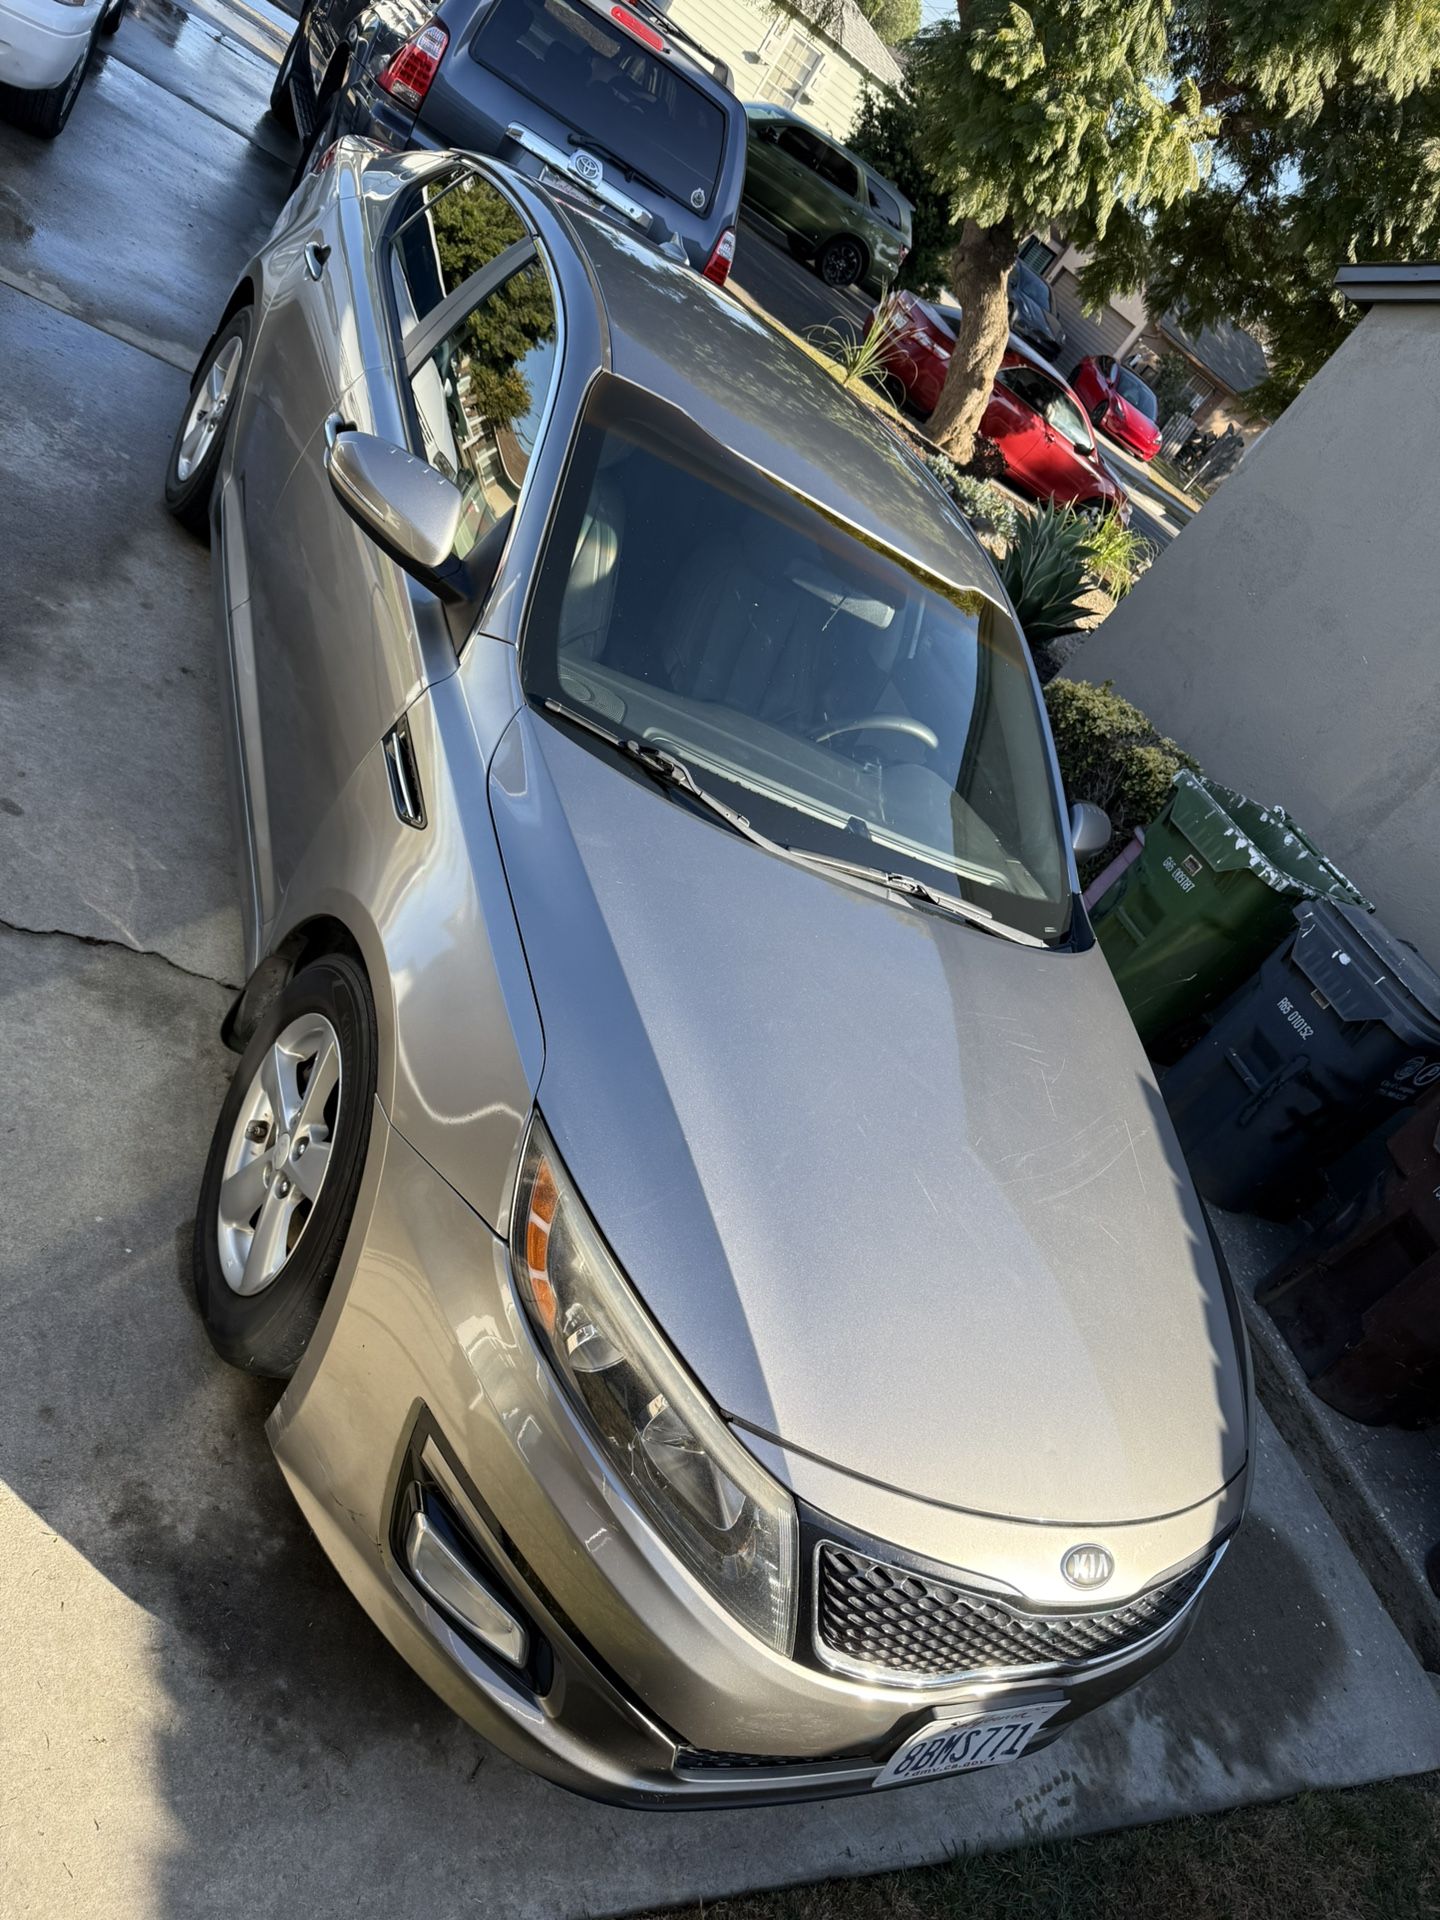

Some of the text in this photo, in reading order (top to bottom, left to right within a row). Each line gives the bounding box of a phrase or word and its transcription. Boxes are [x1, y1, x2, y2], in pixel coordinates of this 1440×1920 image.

[1276, 996, 1314, 1041] R65 010152
[1072, 1553, 1109, 1579] KIA
[893, 1721, 1034, 1776] 8BMS771
